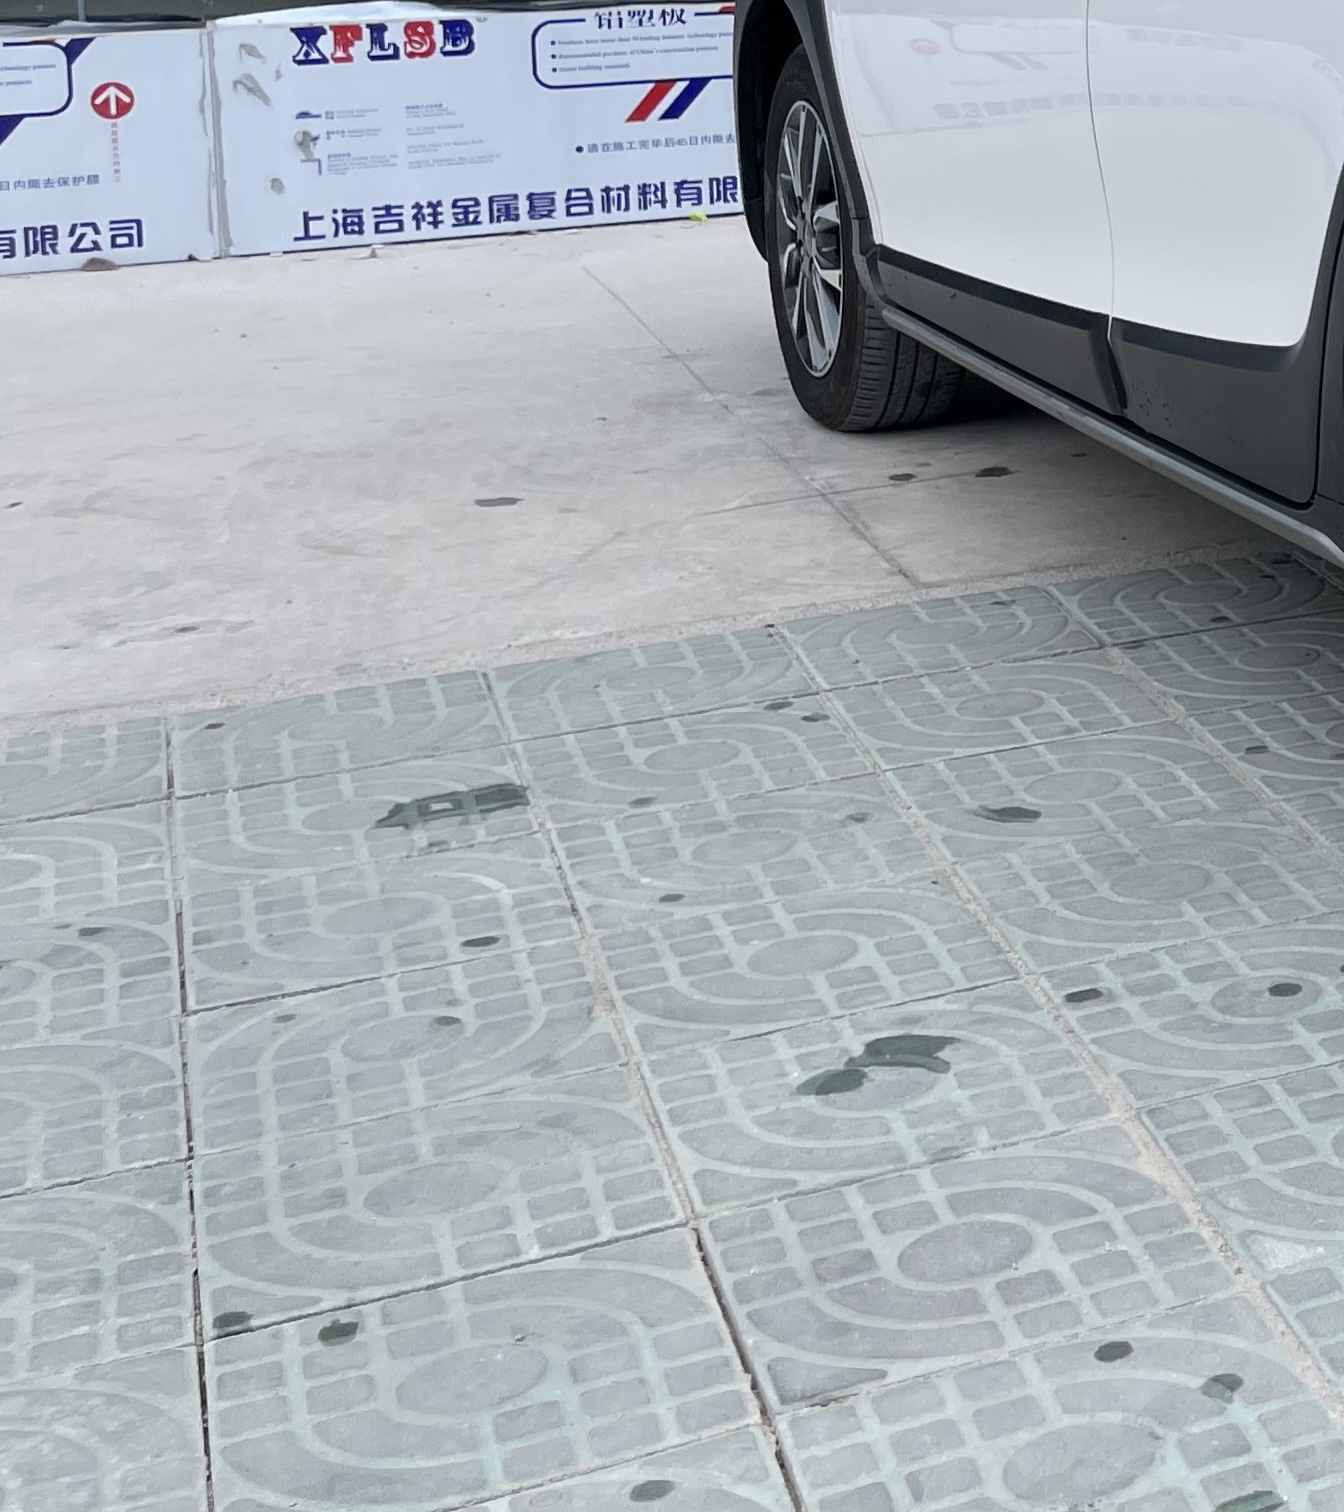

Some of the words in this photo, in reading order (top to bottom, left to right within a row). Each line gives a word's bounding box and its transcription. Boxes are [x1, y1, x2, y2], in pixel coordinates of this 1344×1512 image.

[293, 175, 739, 242] 上海吉祥金属复合材料有限
